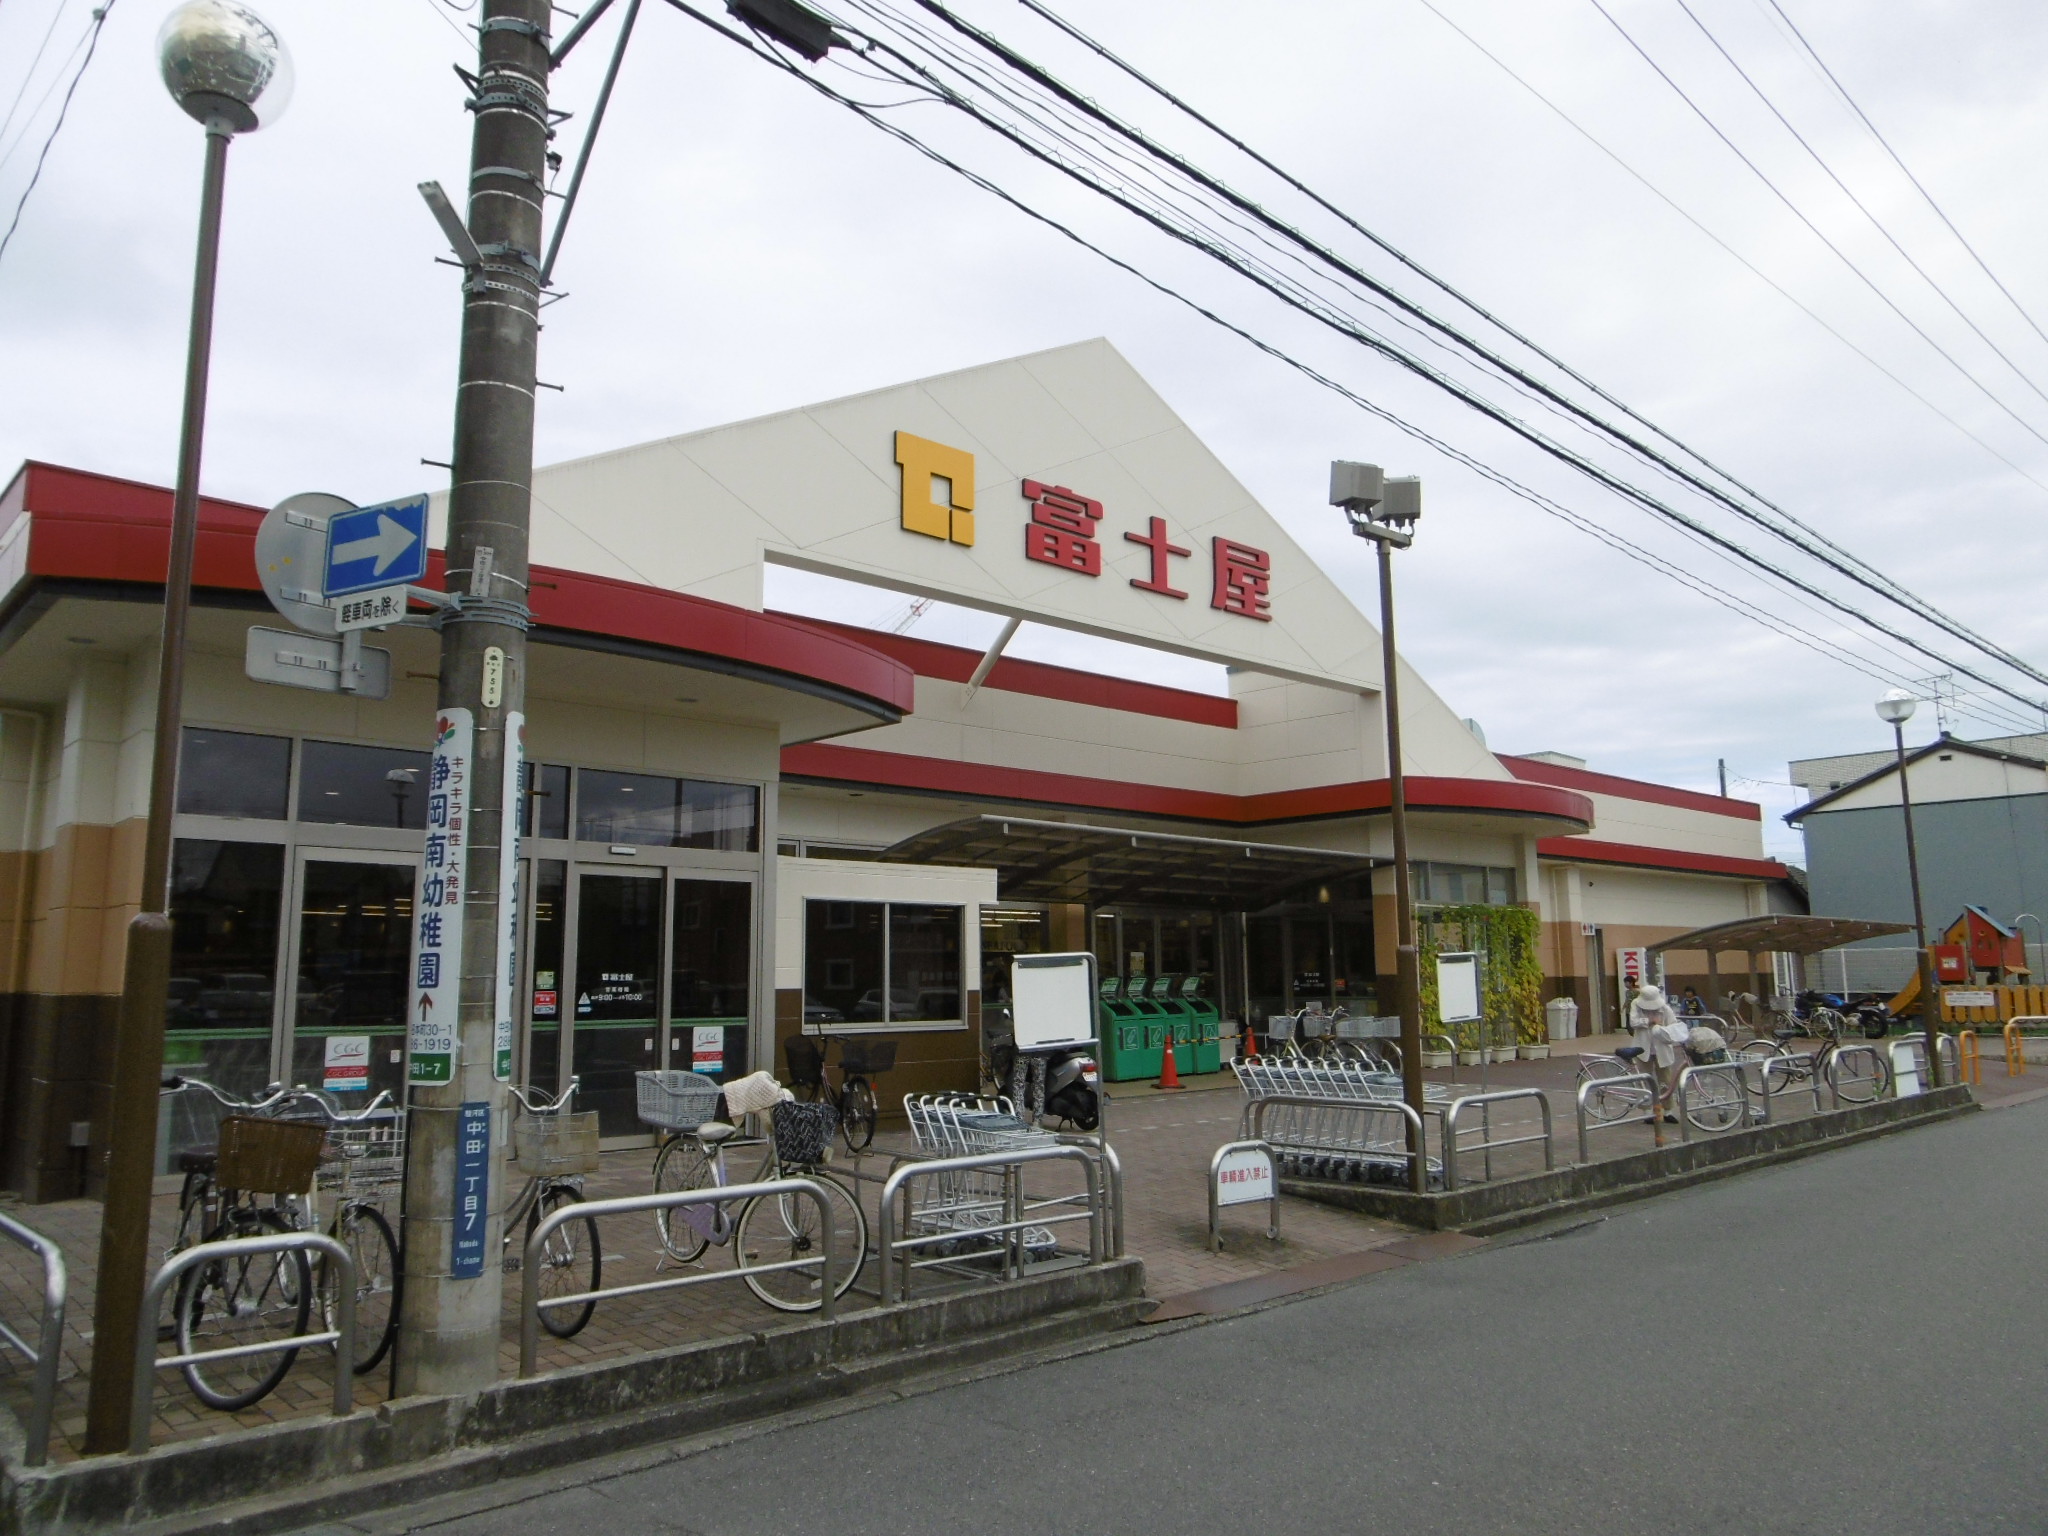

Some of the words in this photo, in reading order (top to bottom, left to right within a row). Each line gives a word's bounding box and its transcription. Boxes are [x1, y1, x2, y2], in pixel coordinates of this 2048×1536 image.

[1022, 478, 1272, 621] 富士屋
[341, 595, 399, 624] 軽車両を除く
[418, 754, 450, 988] 静岡南幼稚園
[445, 756, 463, 905] キラキラ個性・大発見
[334, 1043, 364, 1054] CGC
[698, 1032, 720, 1041] CGC
